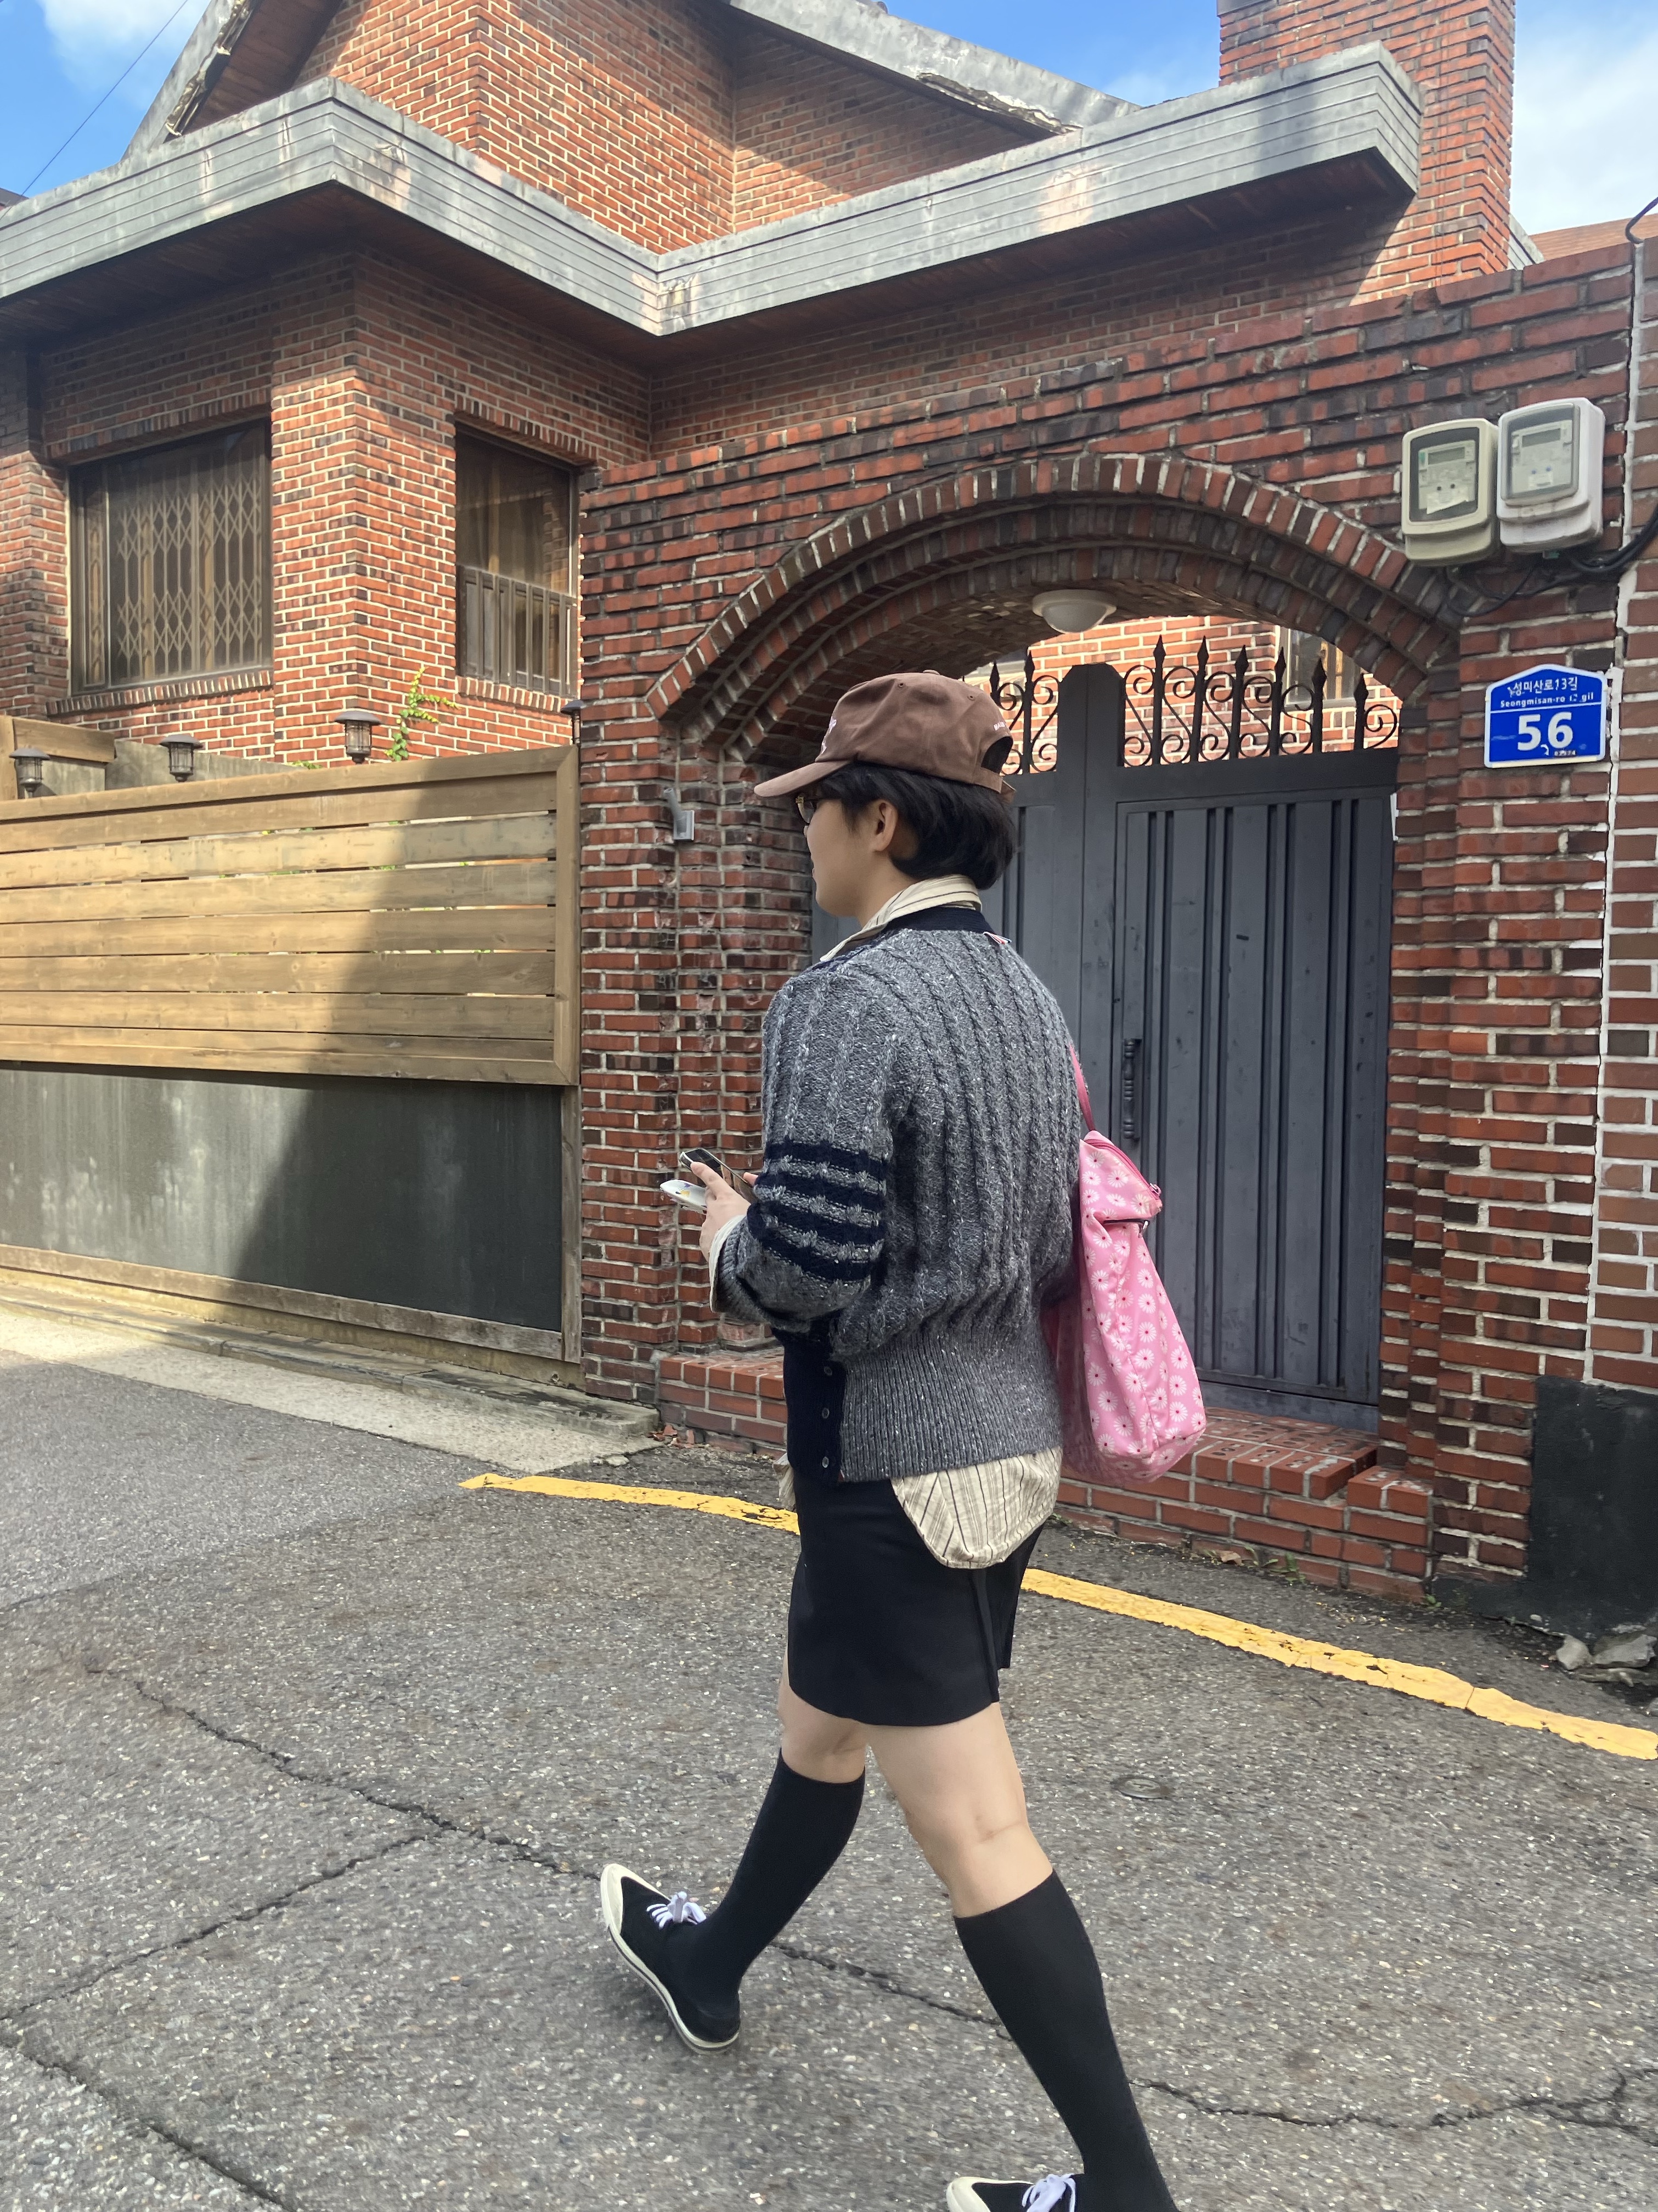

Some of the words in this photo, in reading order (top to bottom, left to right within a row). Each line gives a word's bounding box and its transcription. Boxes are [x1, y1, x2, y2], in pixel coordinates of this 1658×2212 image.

[1514, 676, 1577, 696] 성미산로13길
[1501, 696, 1565, 708] Seongmisan-ro
[1518, 712, 1573, 751] 56
